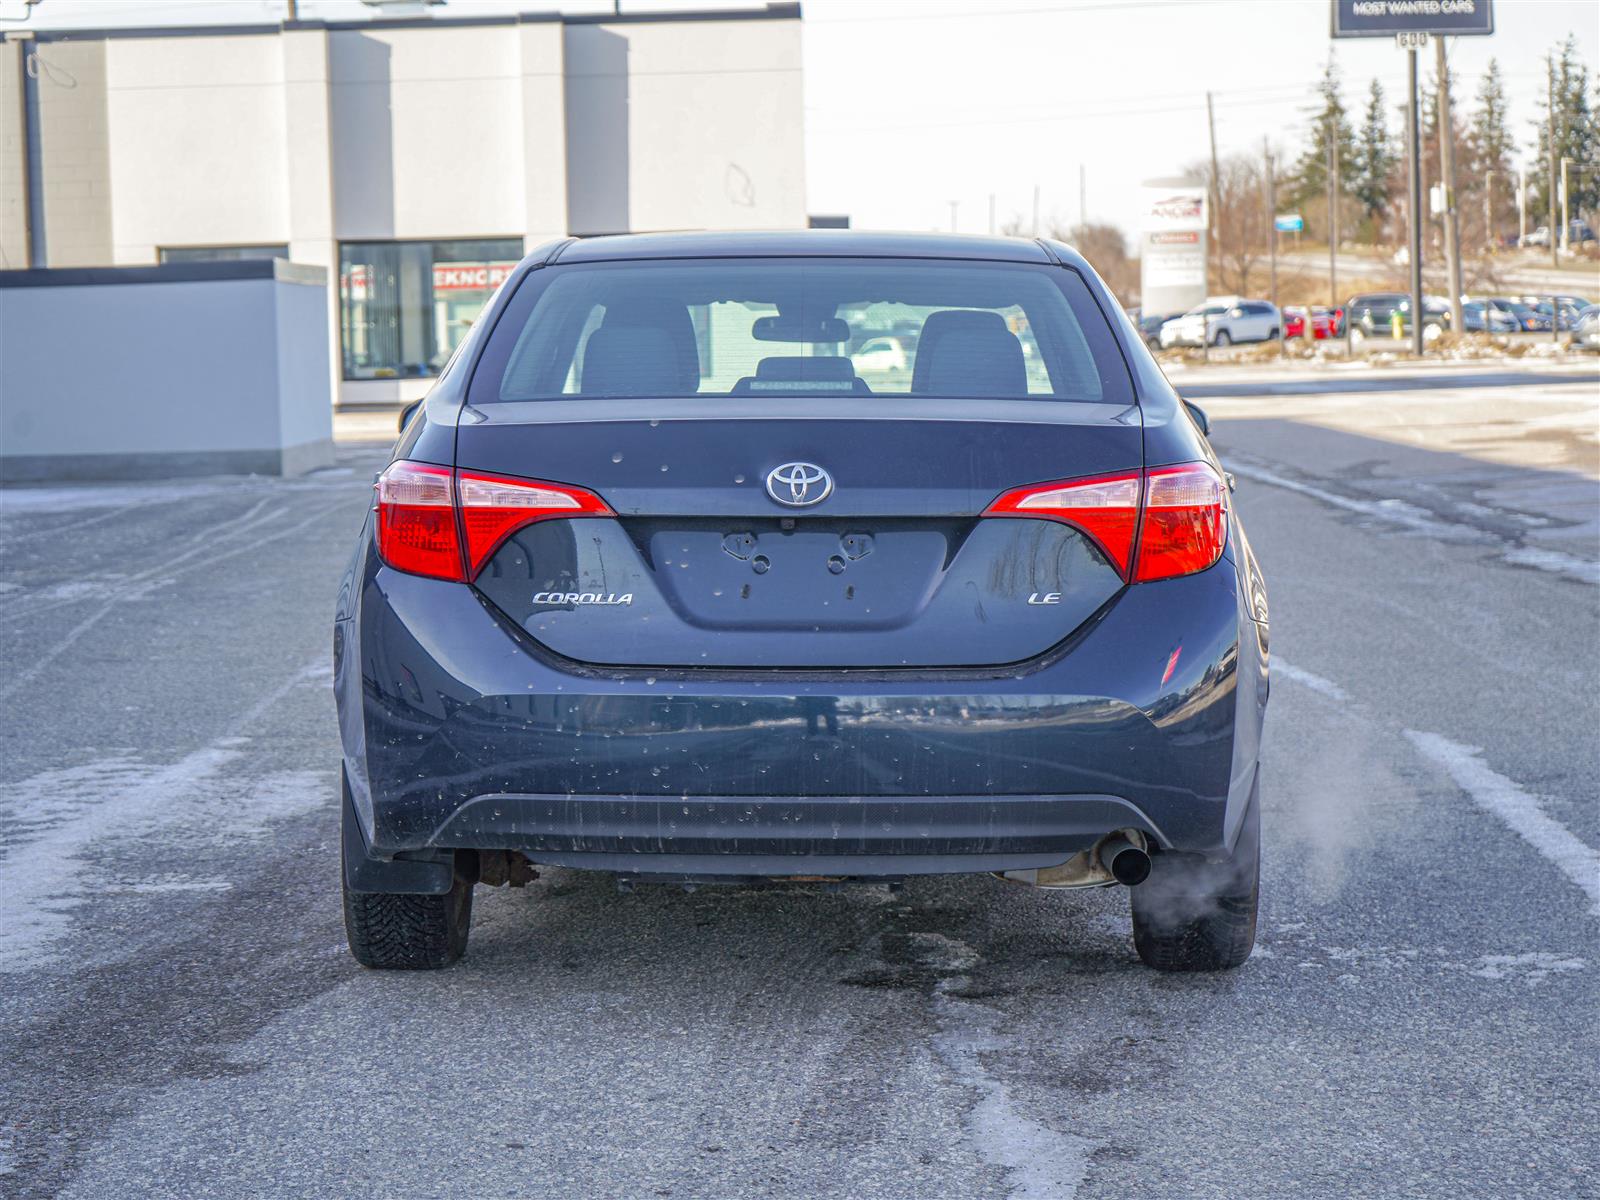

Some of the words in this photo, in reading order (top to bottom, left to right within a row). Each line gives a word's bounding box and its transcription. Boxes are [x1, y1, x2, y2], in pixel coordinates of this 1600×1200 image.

[1353, 1, 1386, 16] MOST
[1388, 0, 1441, 15] WANTED
[1441, 0, 1475, 15] CARS
[532, 592, 633, 605] COROLLA
[1028, 592, 1062, 605] LE
